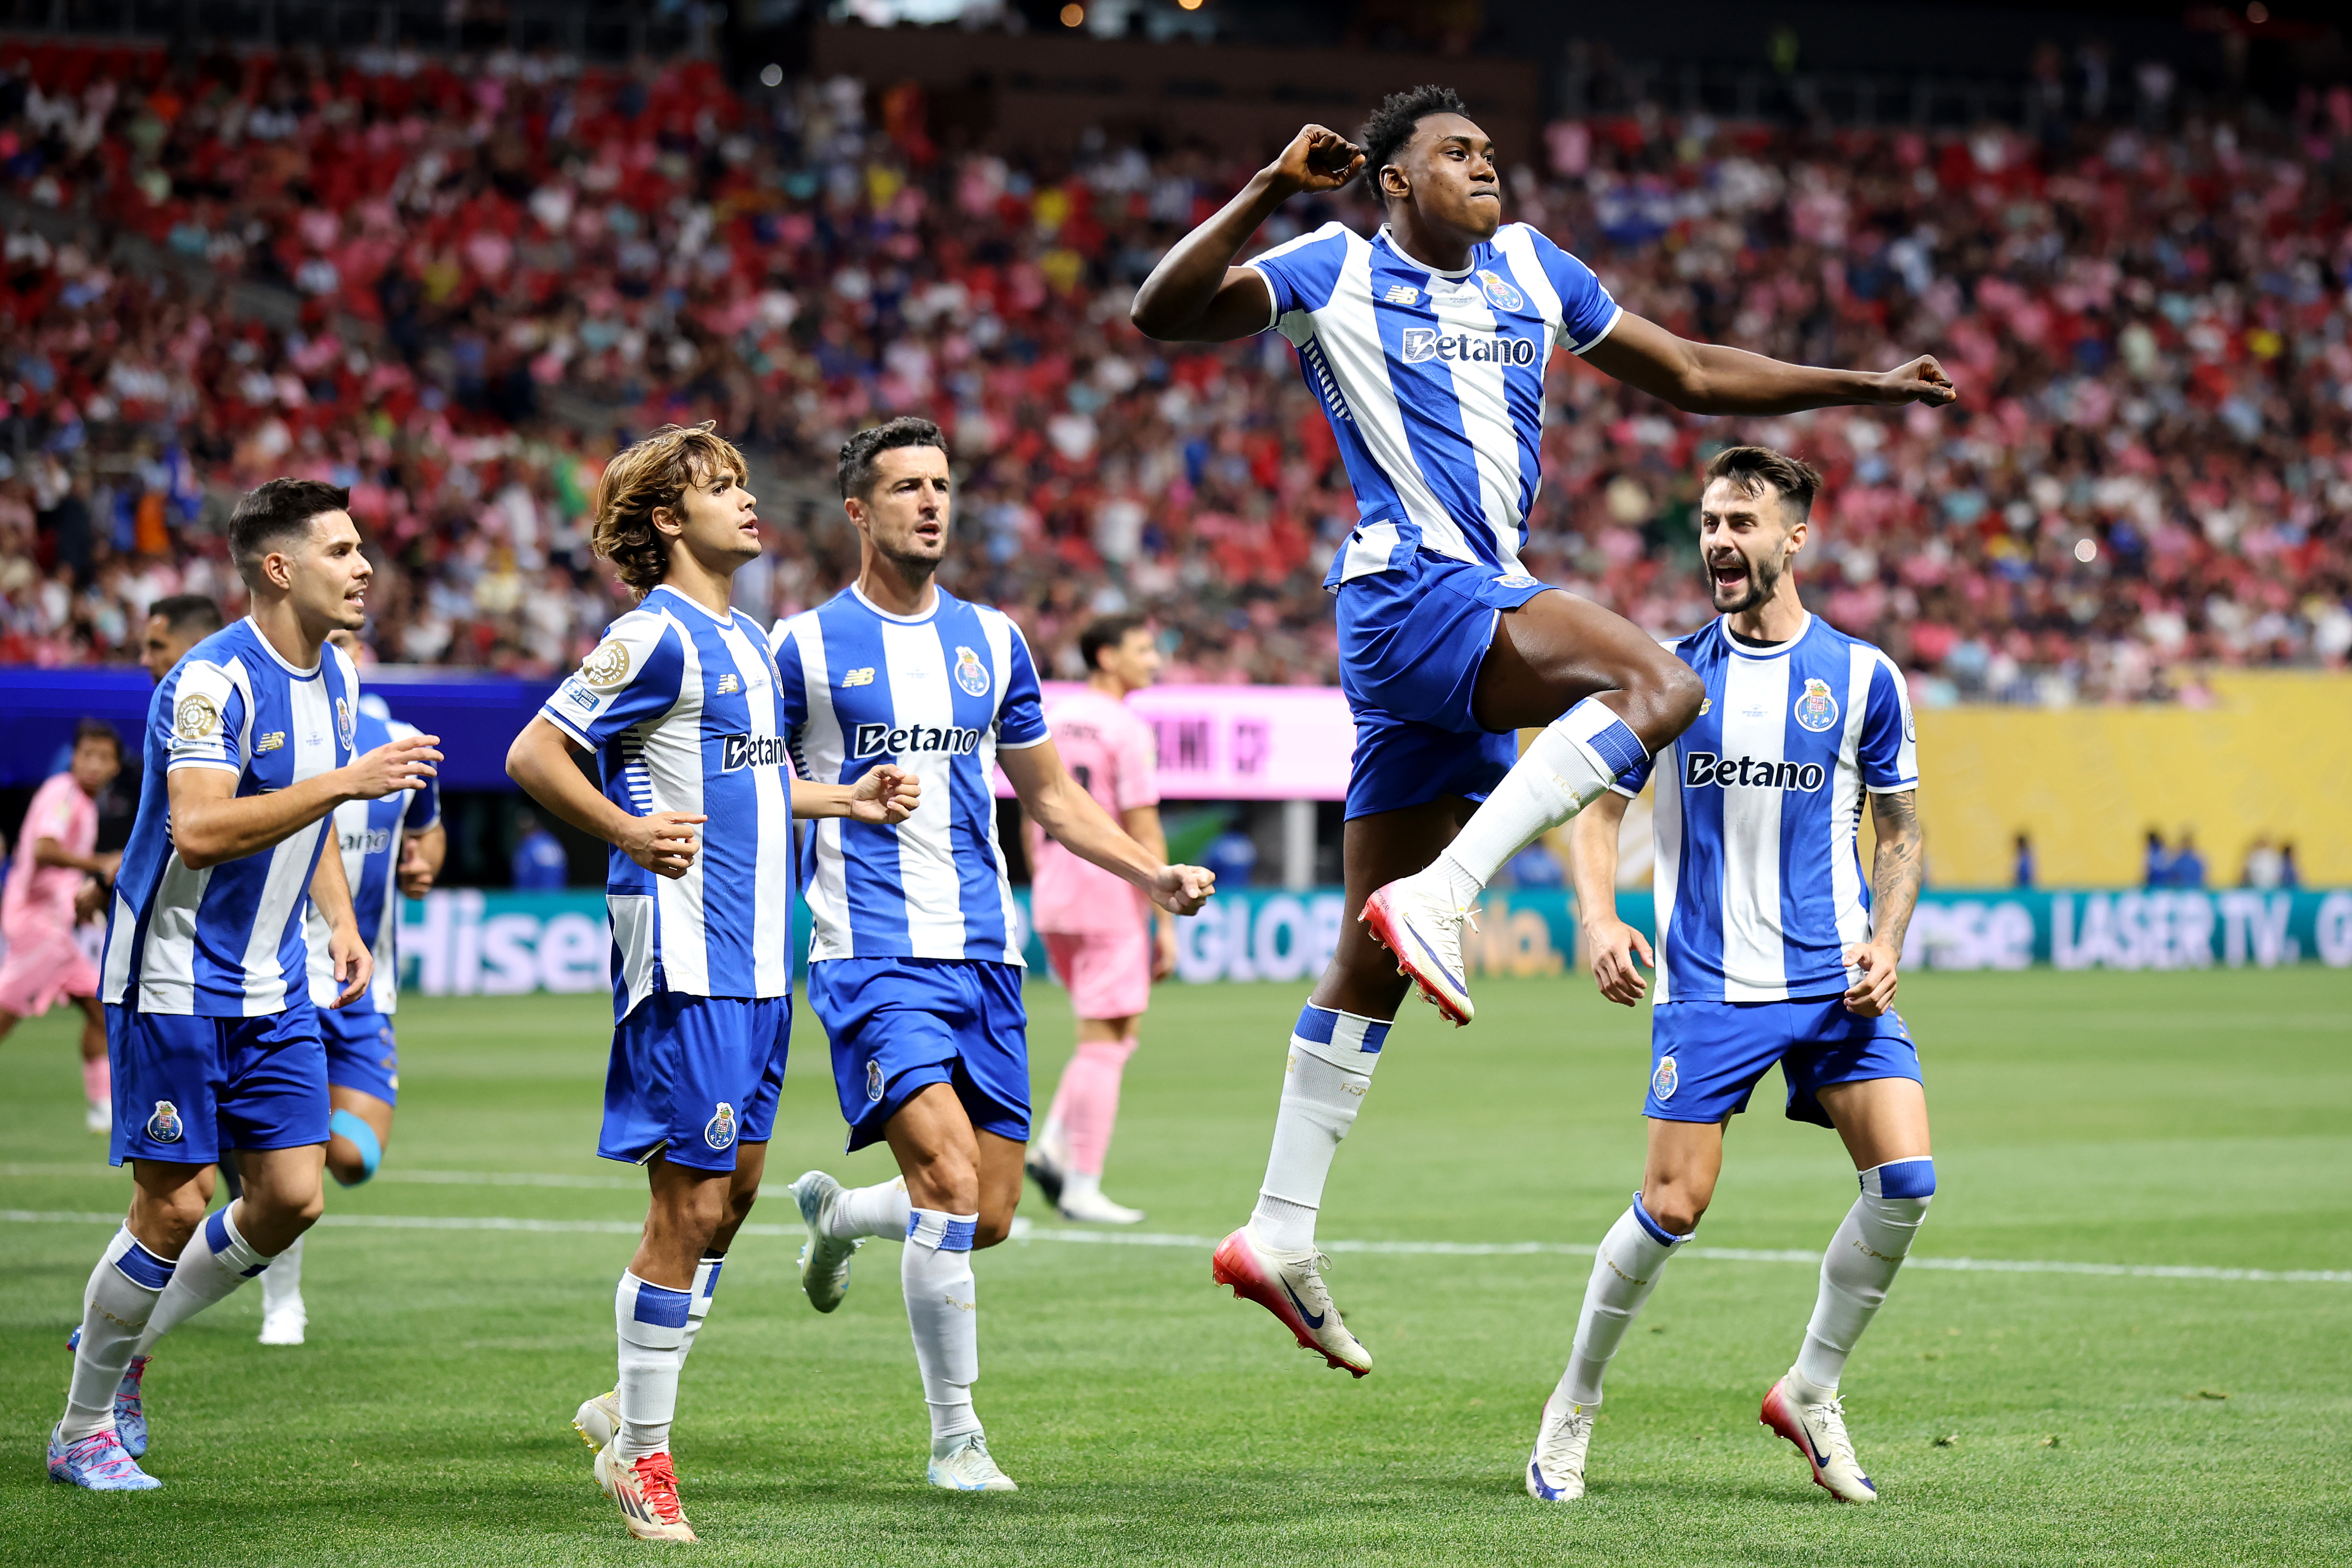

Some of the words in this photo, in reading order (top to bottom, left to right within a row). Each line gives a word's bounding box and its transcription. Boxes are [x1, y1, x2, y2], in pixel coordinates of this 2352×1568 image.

[1403, 328, 1536, 367] Betano
[608, 671, 621, 682] USA
[722, 733, 788, 772] Betan
[855, 723, 978, 759] Betano
[1685, 751, 1825, 792] Betano
[395, 888, 613, 996] Hise
[2051, 889, 2215, 968] LASER
